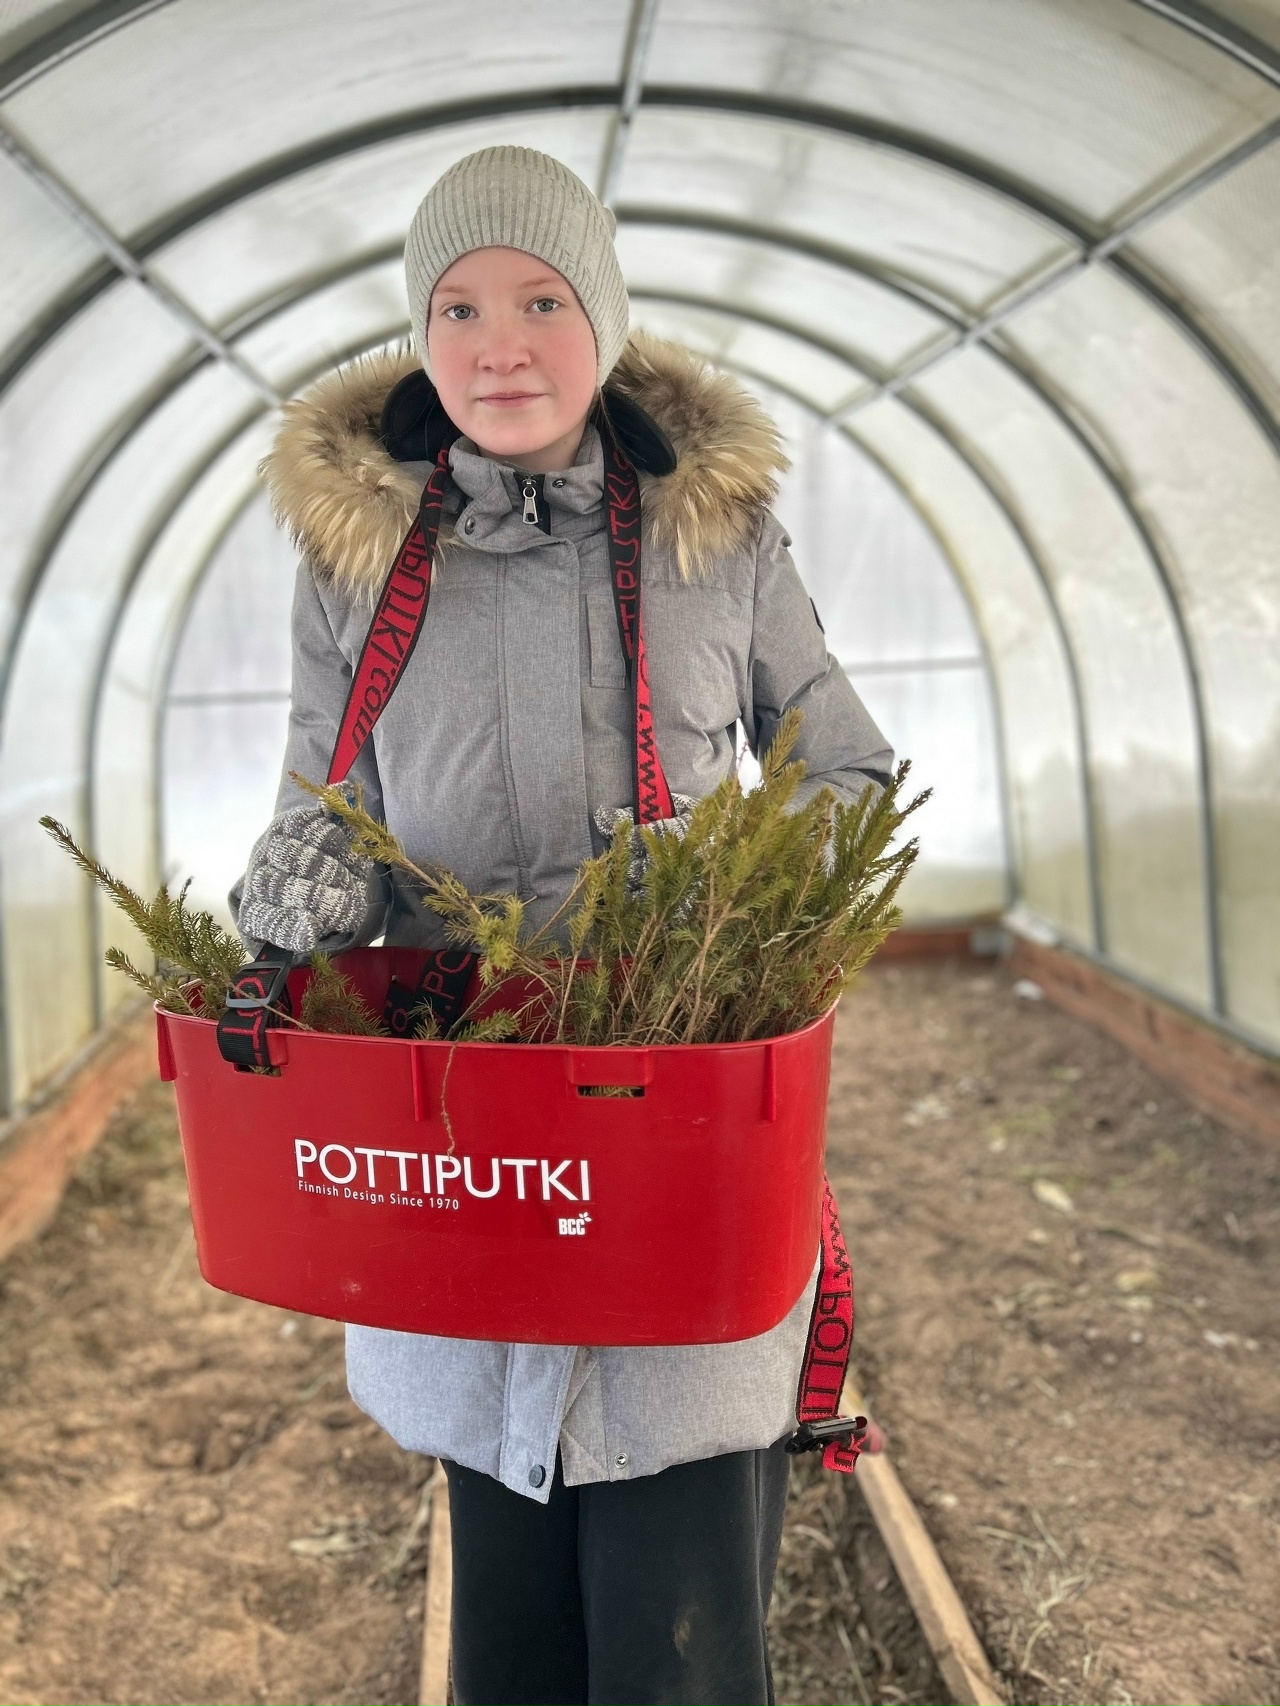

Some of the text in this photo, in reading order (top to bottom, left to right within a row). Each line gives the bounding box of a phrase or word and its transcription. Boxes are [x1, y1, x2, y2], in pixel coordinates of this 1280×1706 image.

[294, 1139, 591, 1201] POTTIPUTKI
[298, 1180, 459, 1210] Finnish Design Since 1970
[558, 1218, 586, 1236] BCC
